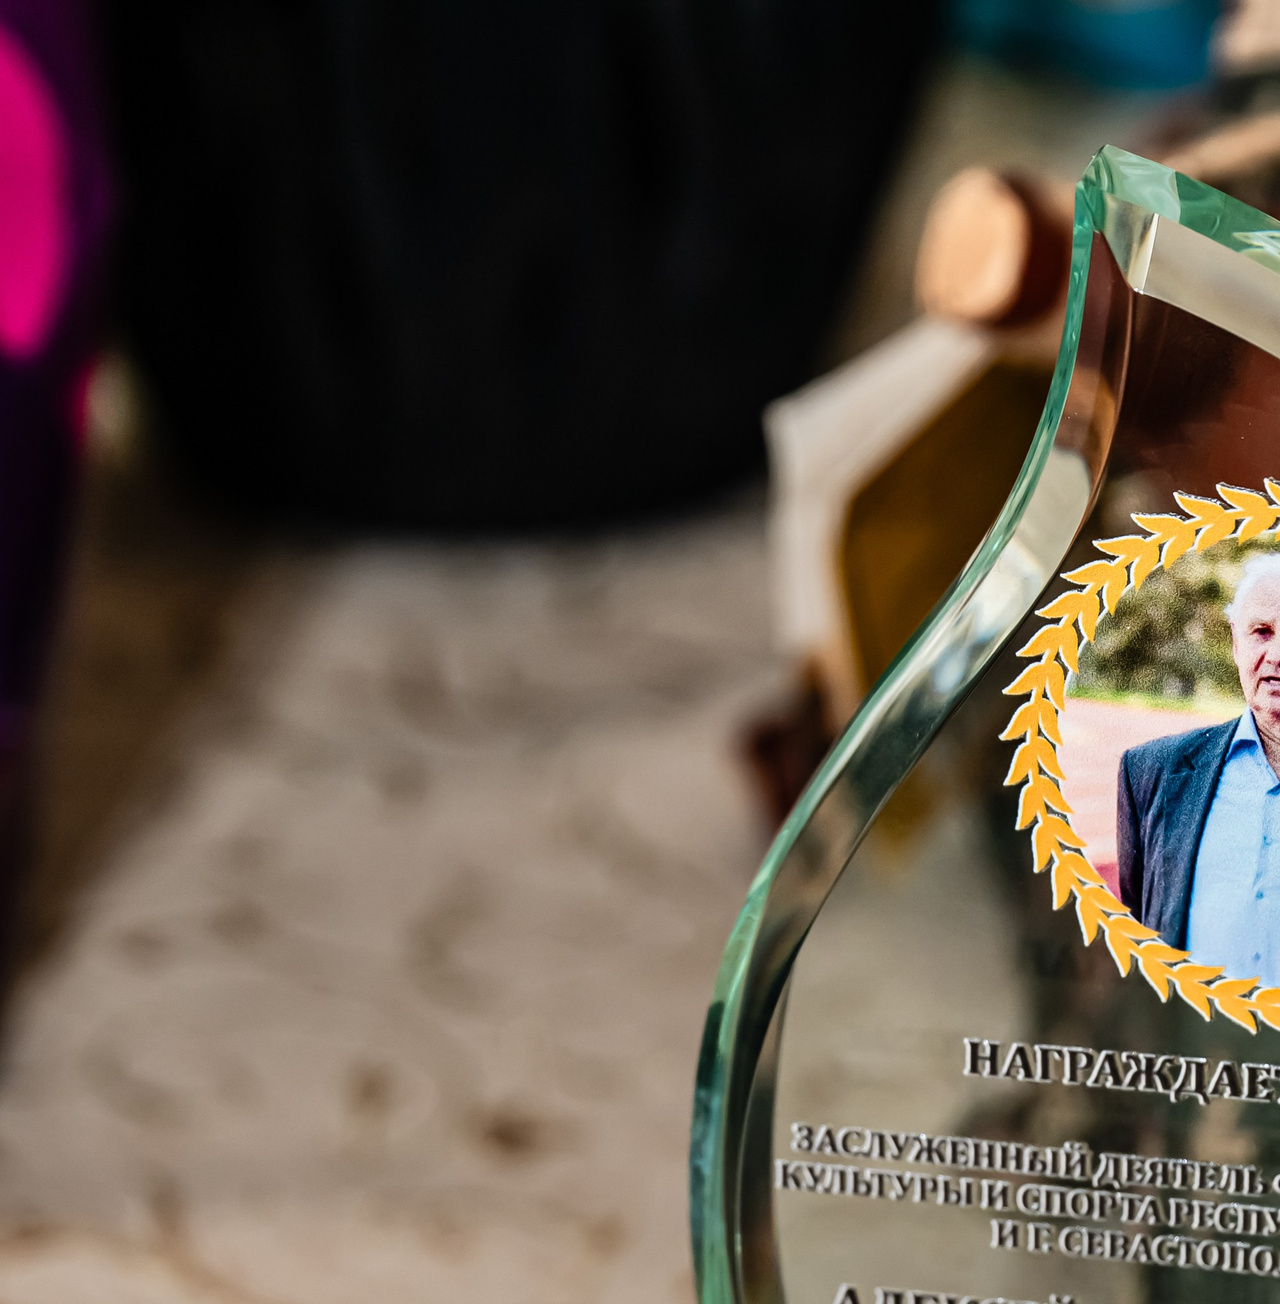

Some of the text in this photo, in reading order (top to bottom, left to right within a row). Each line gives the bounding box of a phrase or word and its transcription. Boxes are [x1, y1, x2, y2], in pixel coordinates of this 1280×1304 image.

[775, 1158, 974, 1207] КУЛЬТУРЫ
[979, 1179, 1011, 1211] И
[1016, 1183, 1161, 1225] СПОРТА
[791, 1122, 1090, 1178] ЗАСЛУЖЕННЫЙ
[1092, 1152, 1266, 1198] ДЕЯТЕЛЬ
[989, 1218, 1021, 1249] И
